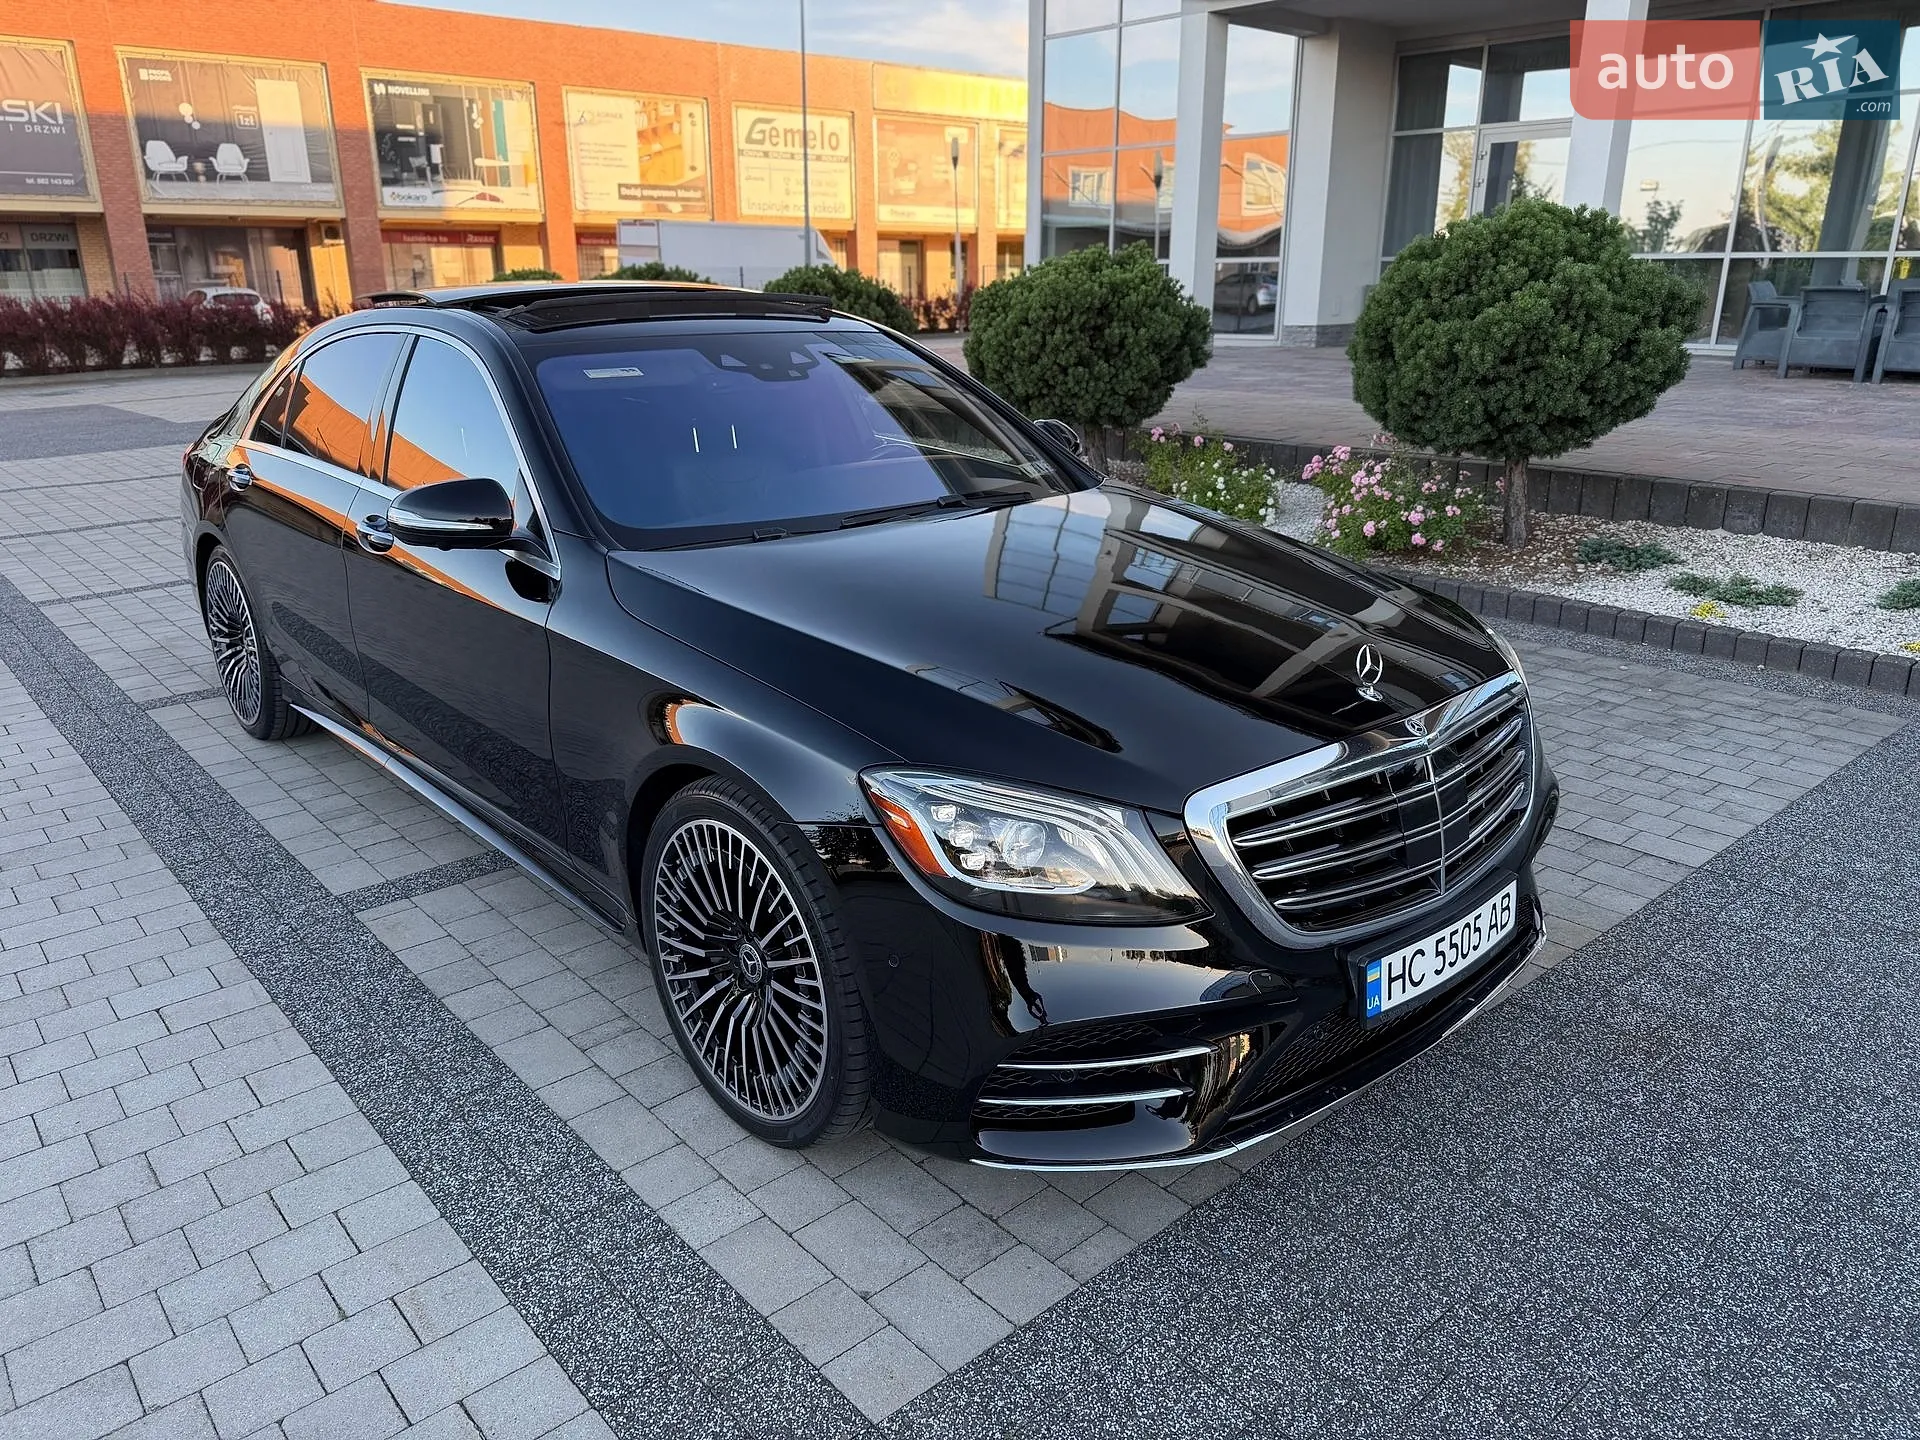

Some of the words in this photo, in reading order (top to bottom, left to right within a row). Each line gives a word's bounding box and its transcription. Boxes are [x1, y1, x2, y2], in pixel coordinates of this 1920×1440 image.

[24, 124, 66, 135] DRZWI
[745, 117, 840, 151] Gemelo
[1387, 948, 1426, 1001] HC
[1433, 912, 1482, 976] 5505
[1487, 891, 1511, 943] AB
[1367, 995, 1380, 1010] UA
